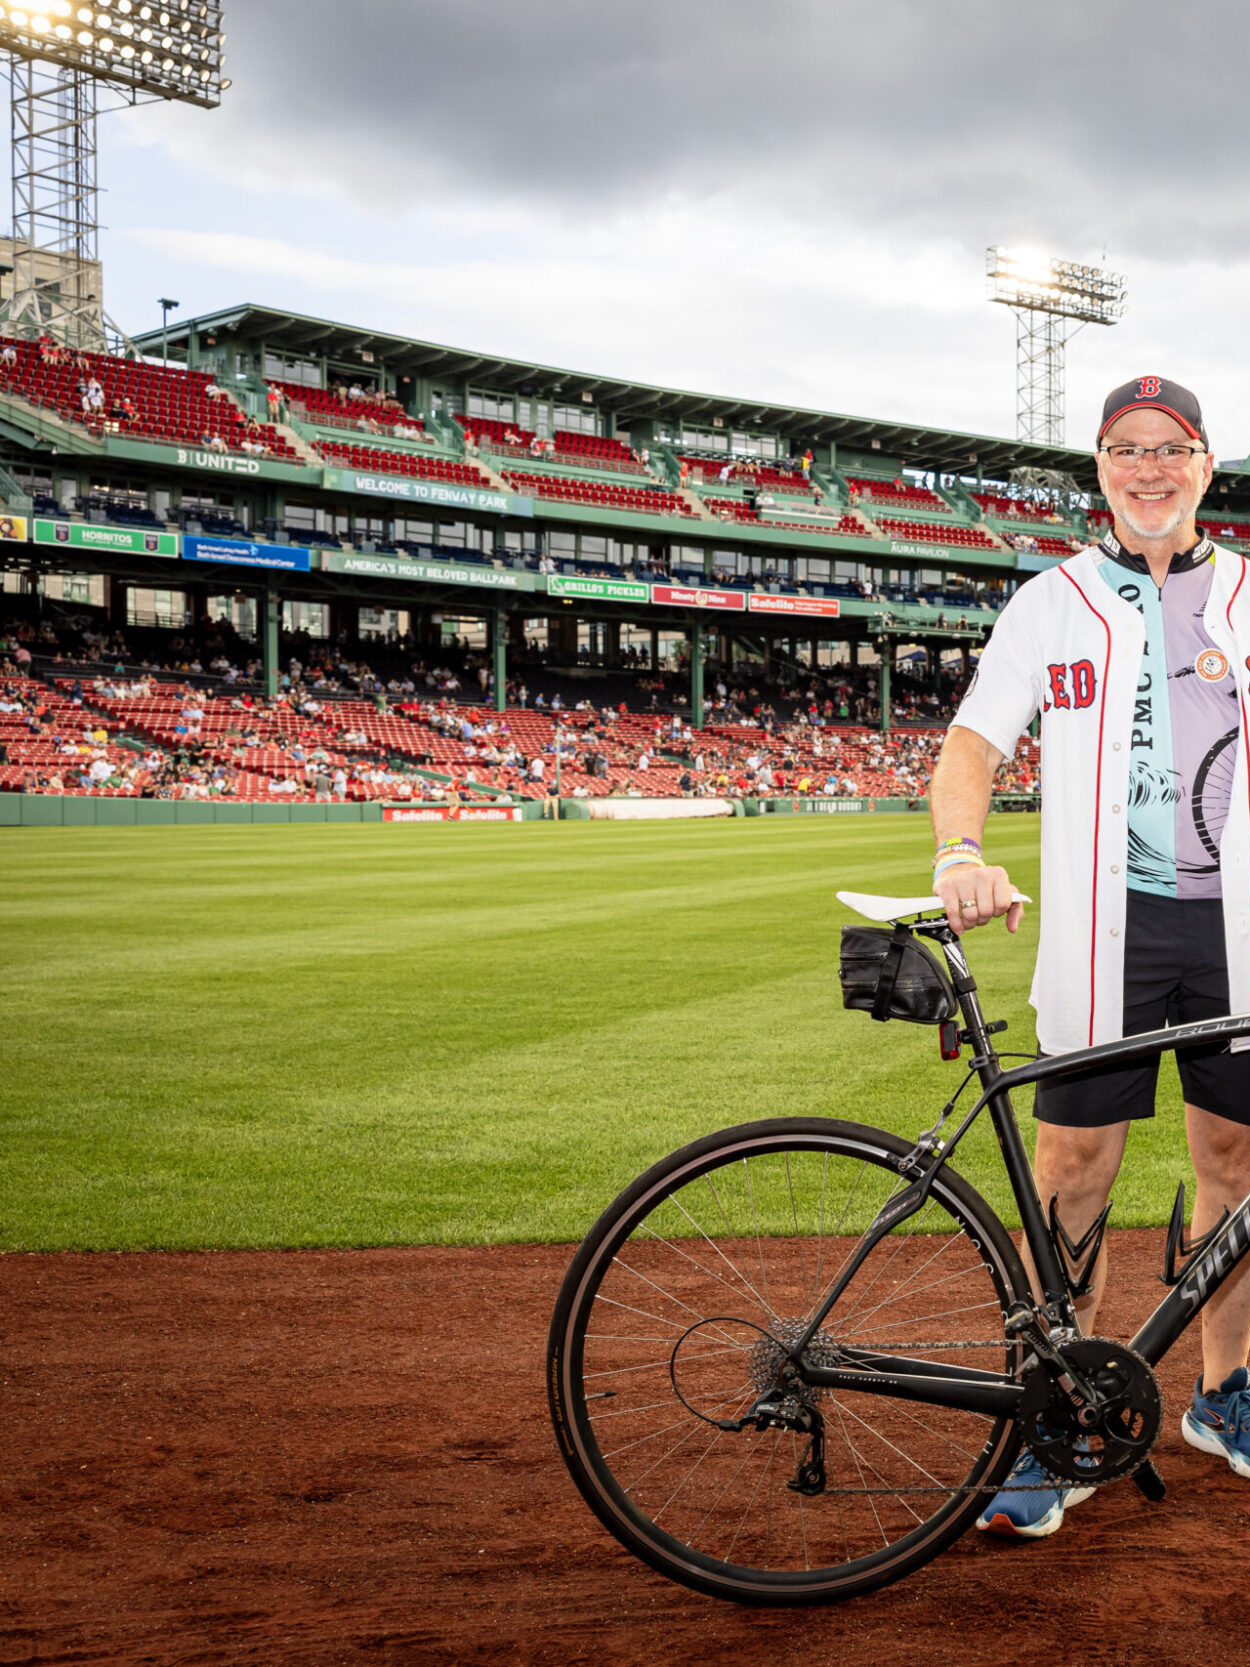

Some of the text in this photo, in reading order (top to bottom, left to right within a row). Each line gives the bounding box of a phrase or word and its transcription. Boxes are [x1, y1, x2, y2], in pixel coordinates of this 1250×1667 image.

[1135, 375, 1162, 398] B
[196, 453, 260, 474] UNITED
[355, 476, 508, 510] WELCOME TO FENWAY PARK
[82, 529, 132, 544] HORNITOS
[917, 546, 949, 558] PAVILION
[344, 559, 517, 586] AMERICA'S MOST BELOVED BALLPARK
[607, 584, 645, 597] PICKLES
[751, 597, 794, 611] Safelite
[1043, 658, 1097, 712] ED
[392, 808, 443, 822] Safelite
[460, 808, 507, 821] Safelite
